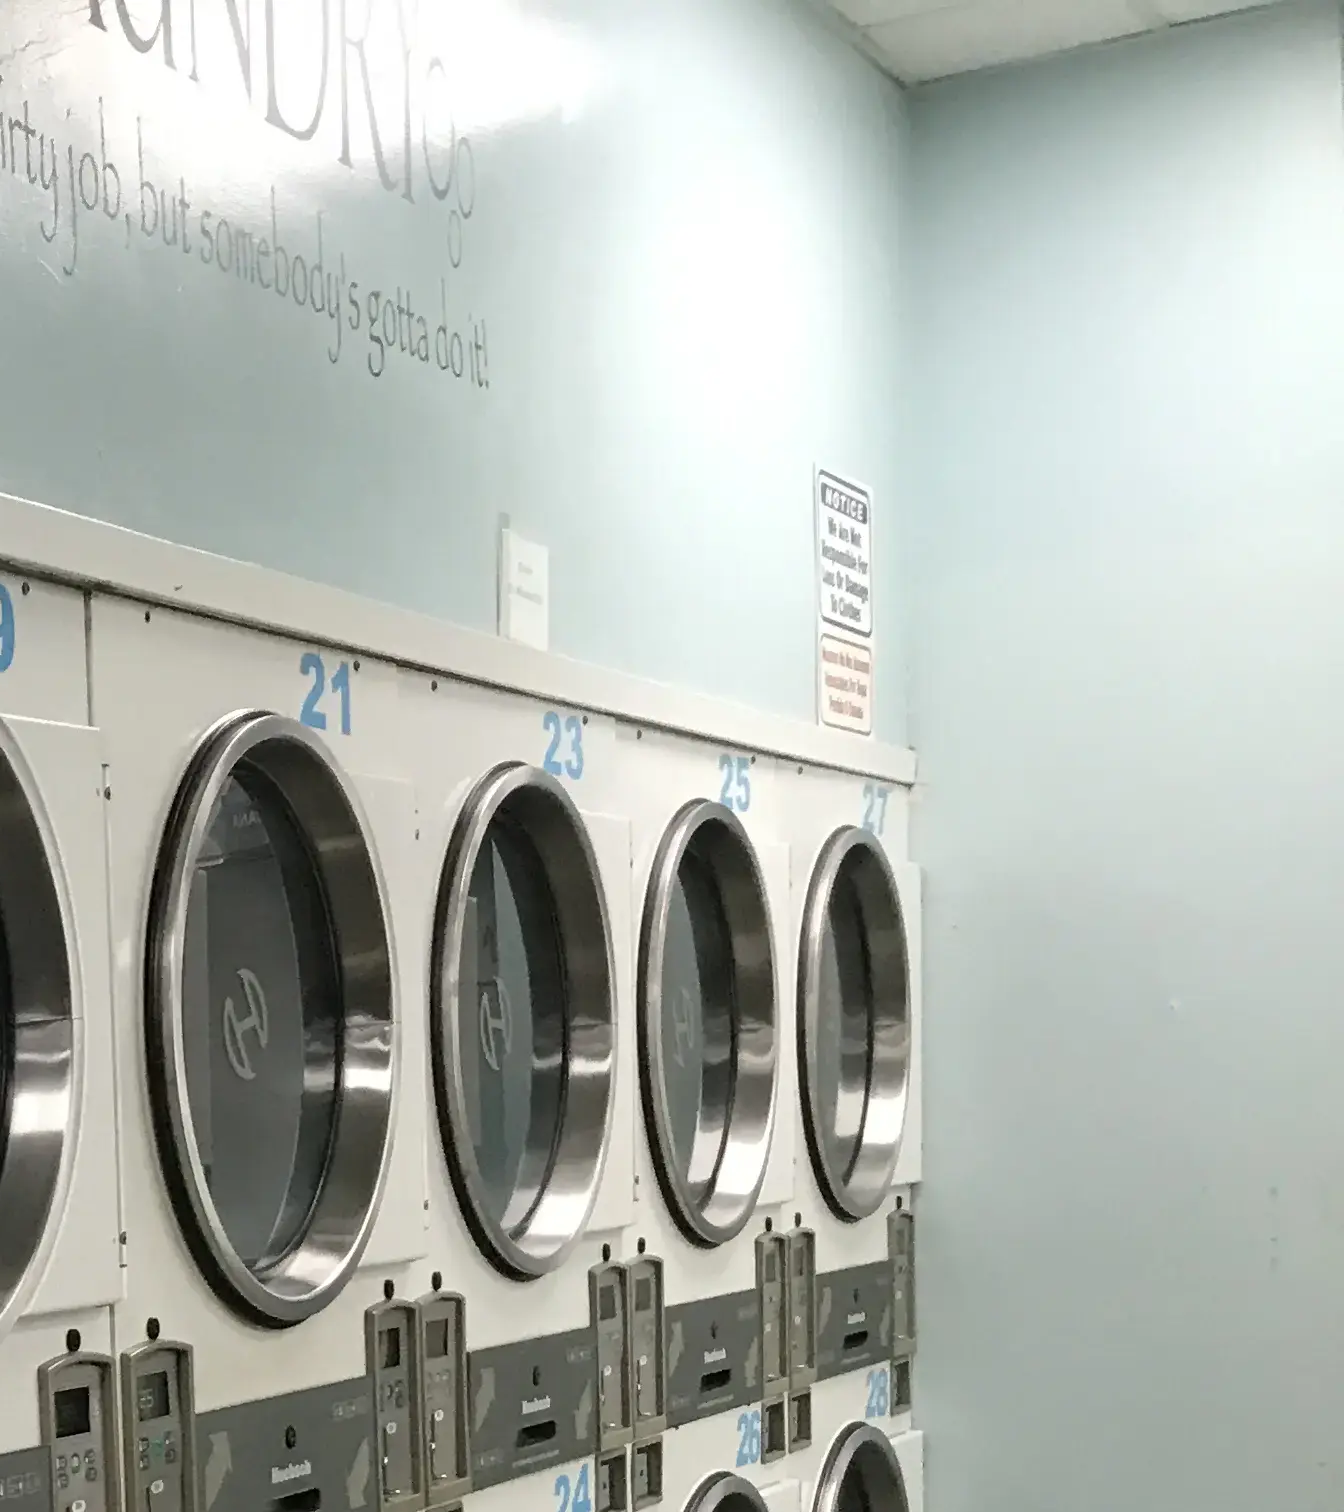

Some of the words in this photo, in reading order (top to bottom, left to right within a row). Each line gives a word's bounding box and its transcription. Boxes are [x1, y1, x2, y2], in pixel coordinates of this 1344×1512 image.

[63, 96, 130, 276] job,
[137, 115, 192, 254] but
[200, 184, 361, 364] somebody's
[368, 286, 431, 377] gotta
[435, 276, 465, 378] do
[825, 486, 864, 521] NOTICE
[299, 654, 351, 733] 21
[543, 711, 584, 780] 23
[719, 757, 750, 812] 25
[735, 1412, 761, 1467] 26
